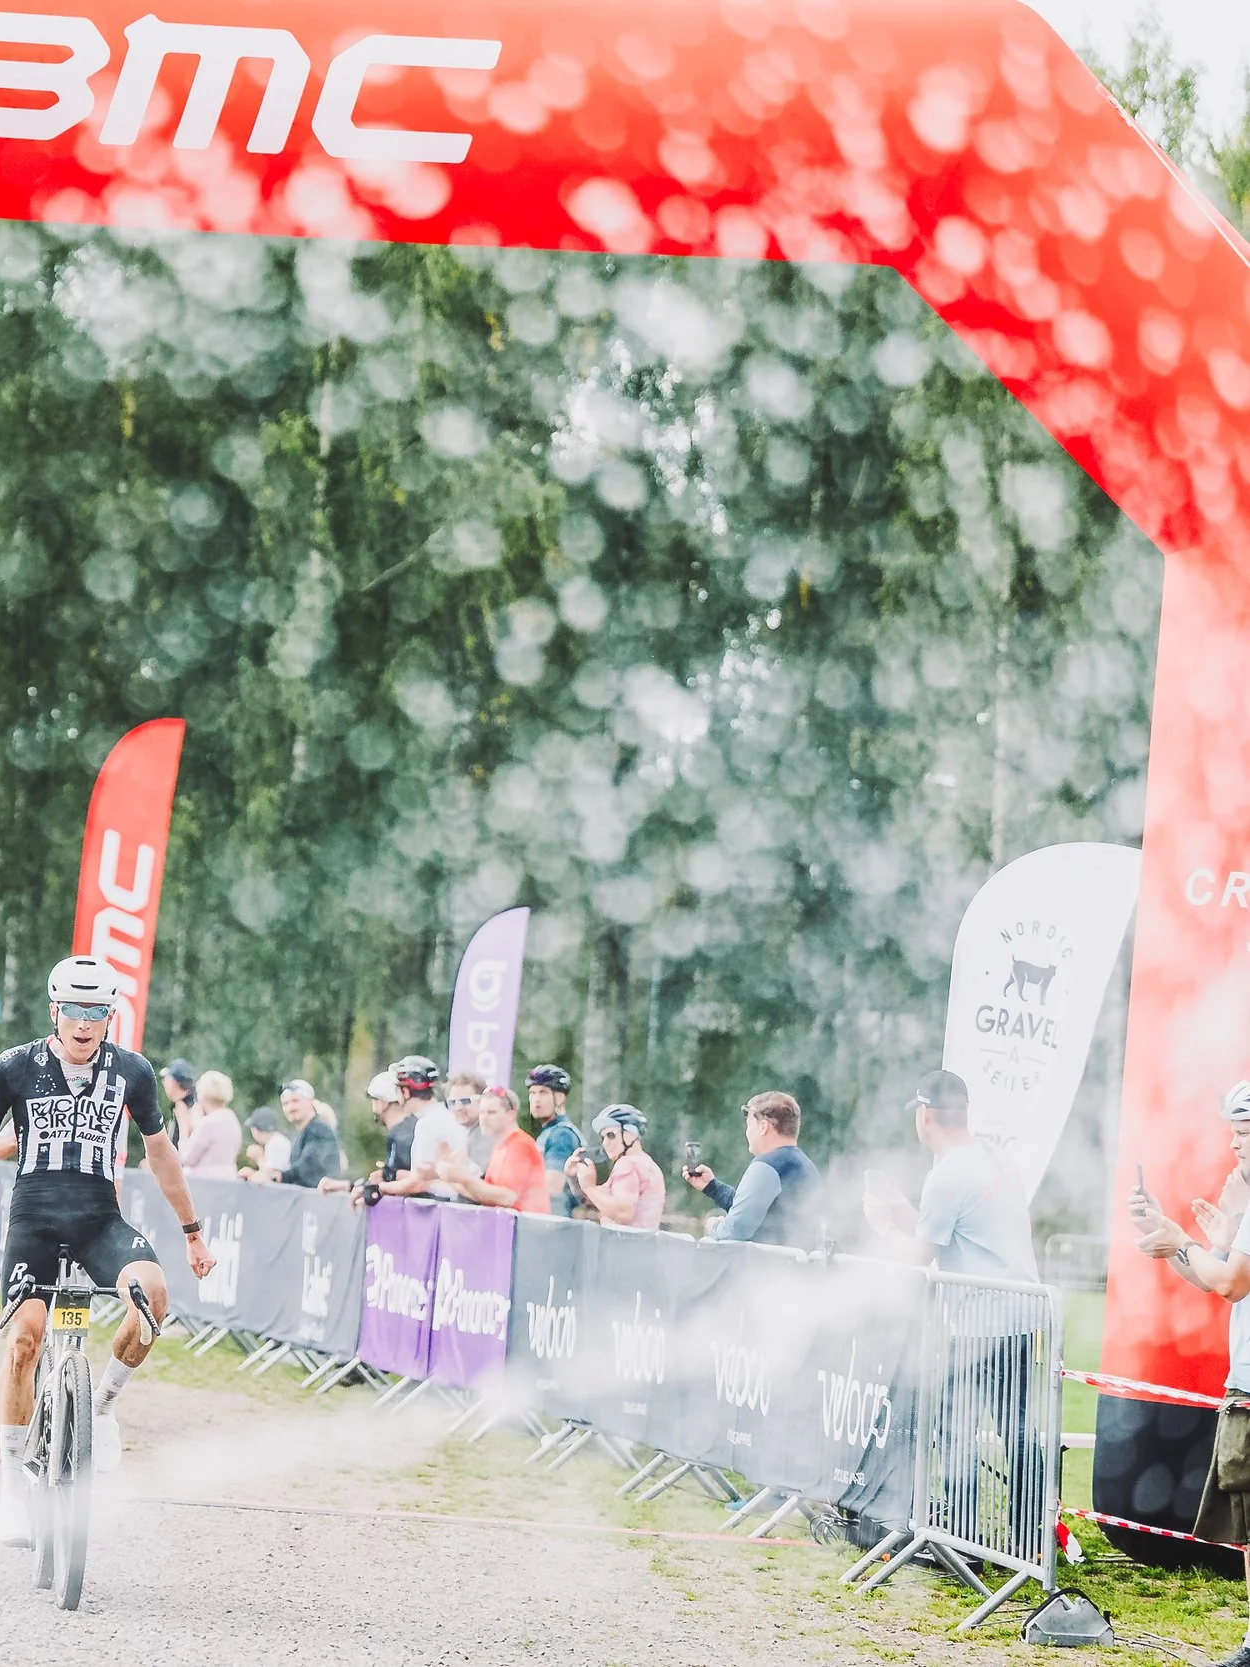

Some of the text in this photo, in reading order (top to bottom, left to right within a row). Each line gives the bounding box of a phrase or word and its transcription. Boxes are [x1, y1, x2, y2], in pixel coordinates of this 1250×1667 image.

[1001, 920, 1072, 959] NORDIC
[975, 1005, 1061, 1050] GRAVEL
[132, 1236, 147, 1249] R
[9, 1262, 28, 1282] R
[61, 1311, 82, 1325] 135
